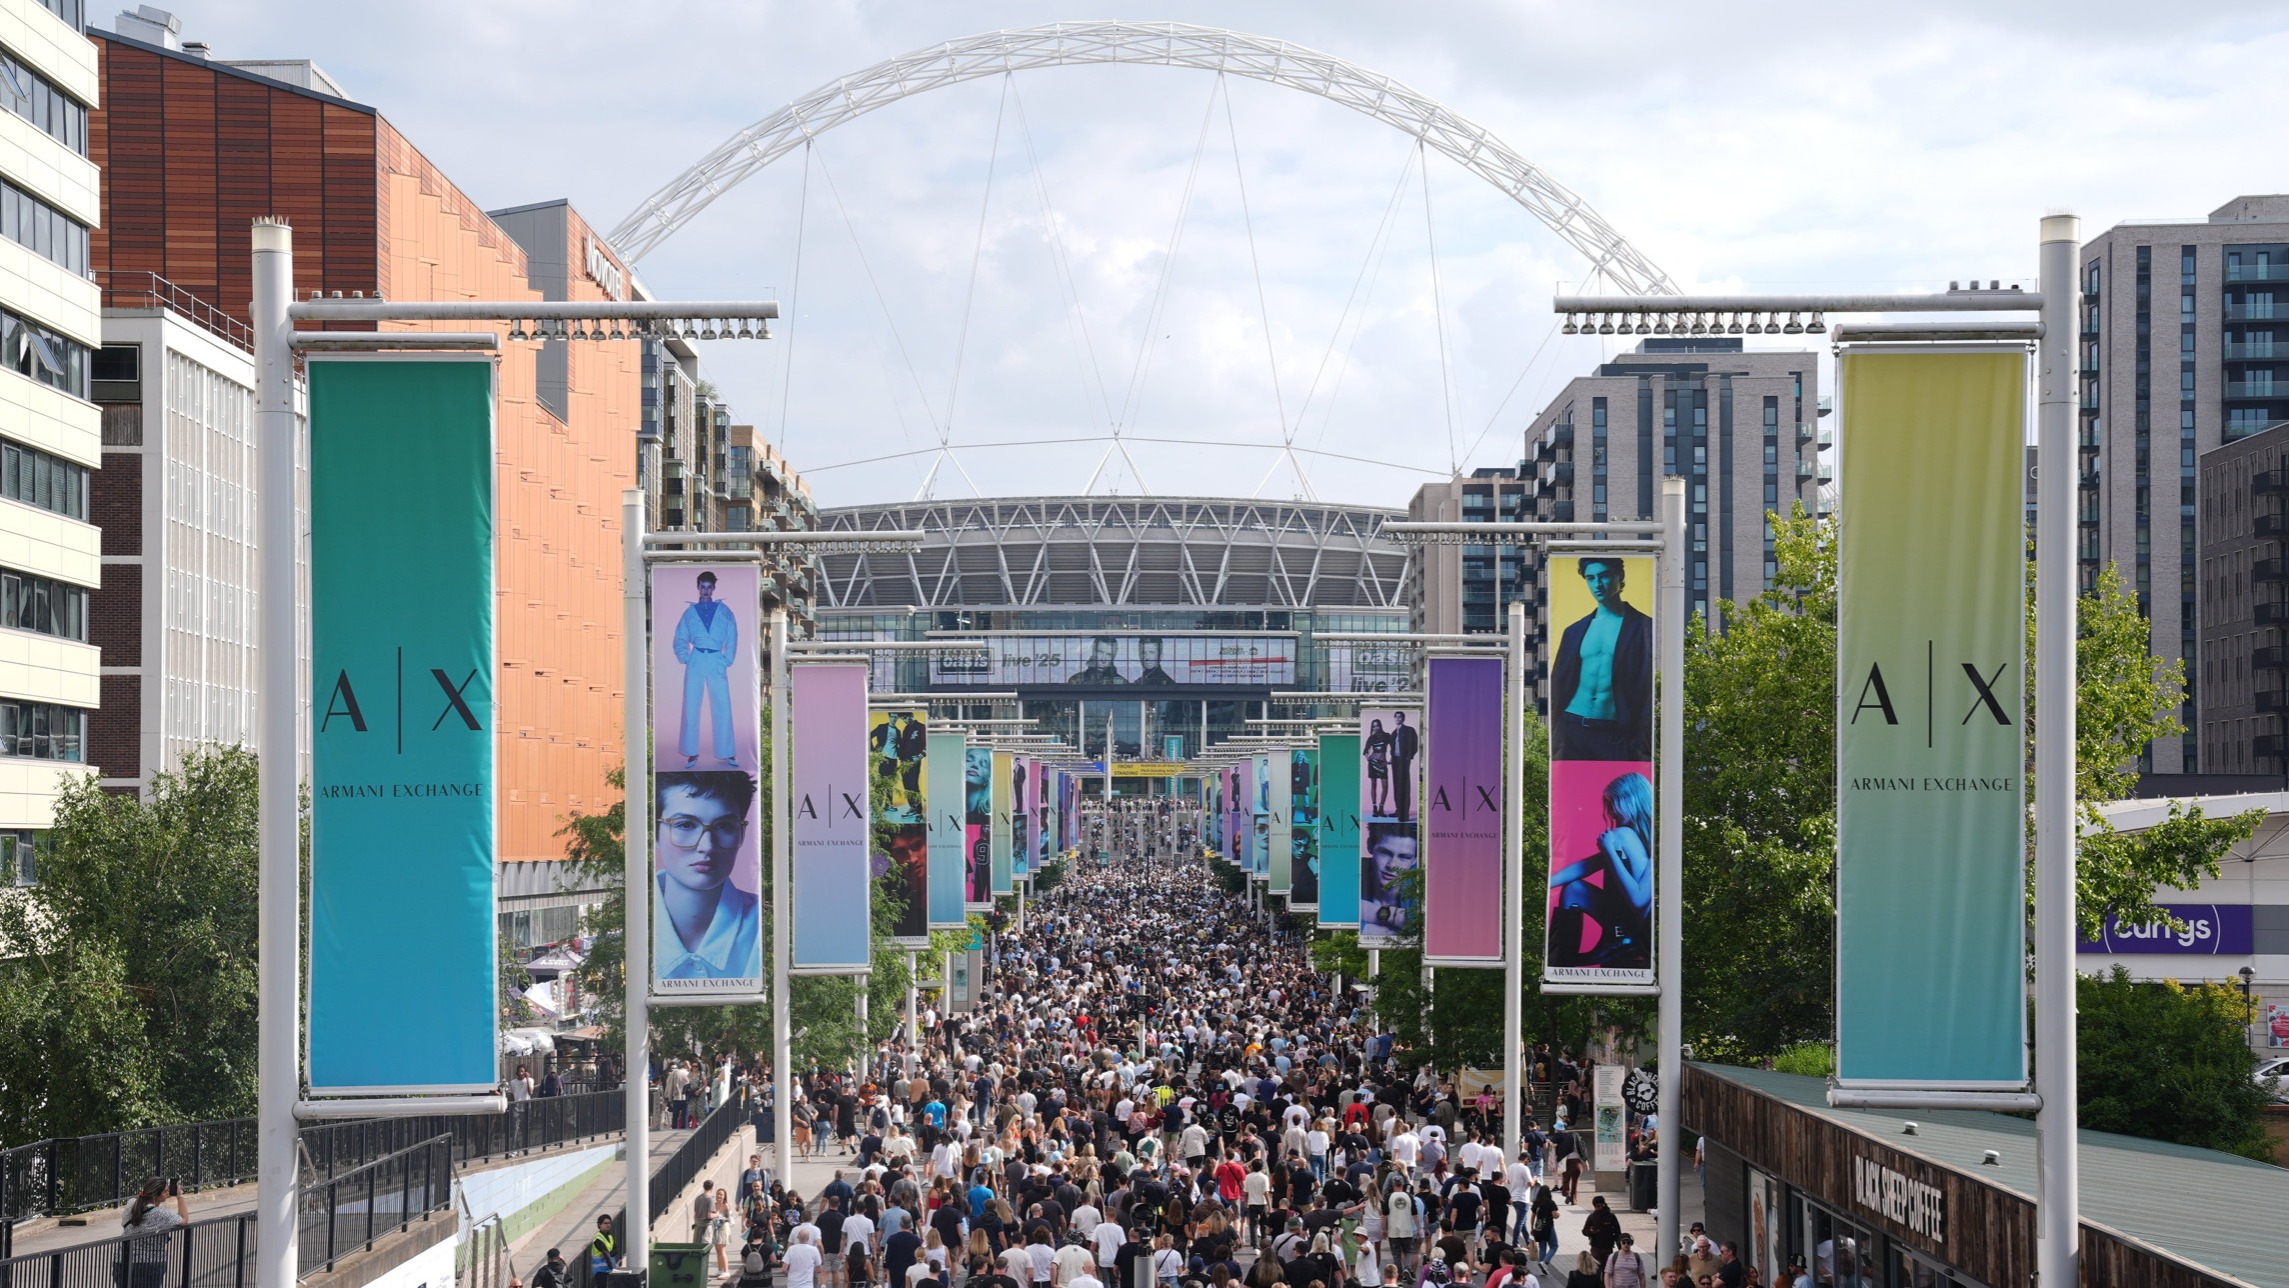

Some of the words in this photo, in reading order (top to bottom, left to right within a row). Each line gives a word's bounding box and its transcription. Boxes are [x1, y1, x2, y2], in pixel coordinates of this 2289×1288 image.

[1002, 653, 1031, 667] live
[1350, 676, 1387, 692] live
[320, 784, 384, 798] ARMANI
[393, 783, 483, 798] EXCHANGE
[1851, 778, 1914, 791] ARMANI
[1924, 778, 2013, 791] EXCHANGE
[1551, 968, 1590, 976] ARMANI
[1594, 969, 1646, 978] EXCHANGE
[660, 980, 699, 988] ARMANI
[703, 979, 755, 987] EXCHANGE
[1855, 1155, 1881, 1213] BLACK
[1881, 1166, 1908, 1225] SHEEP
[1908, 1178, 1943, 1244] COFFEE
